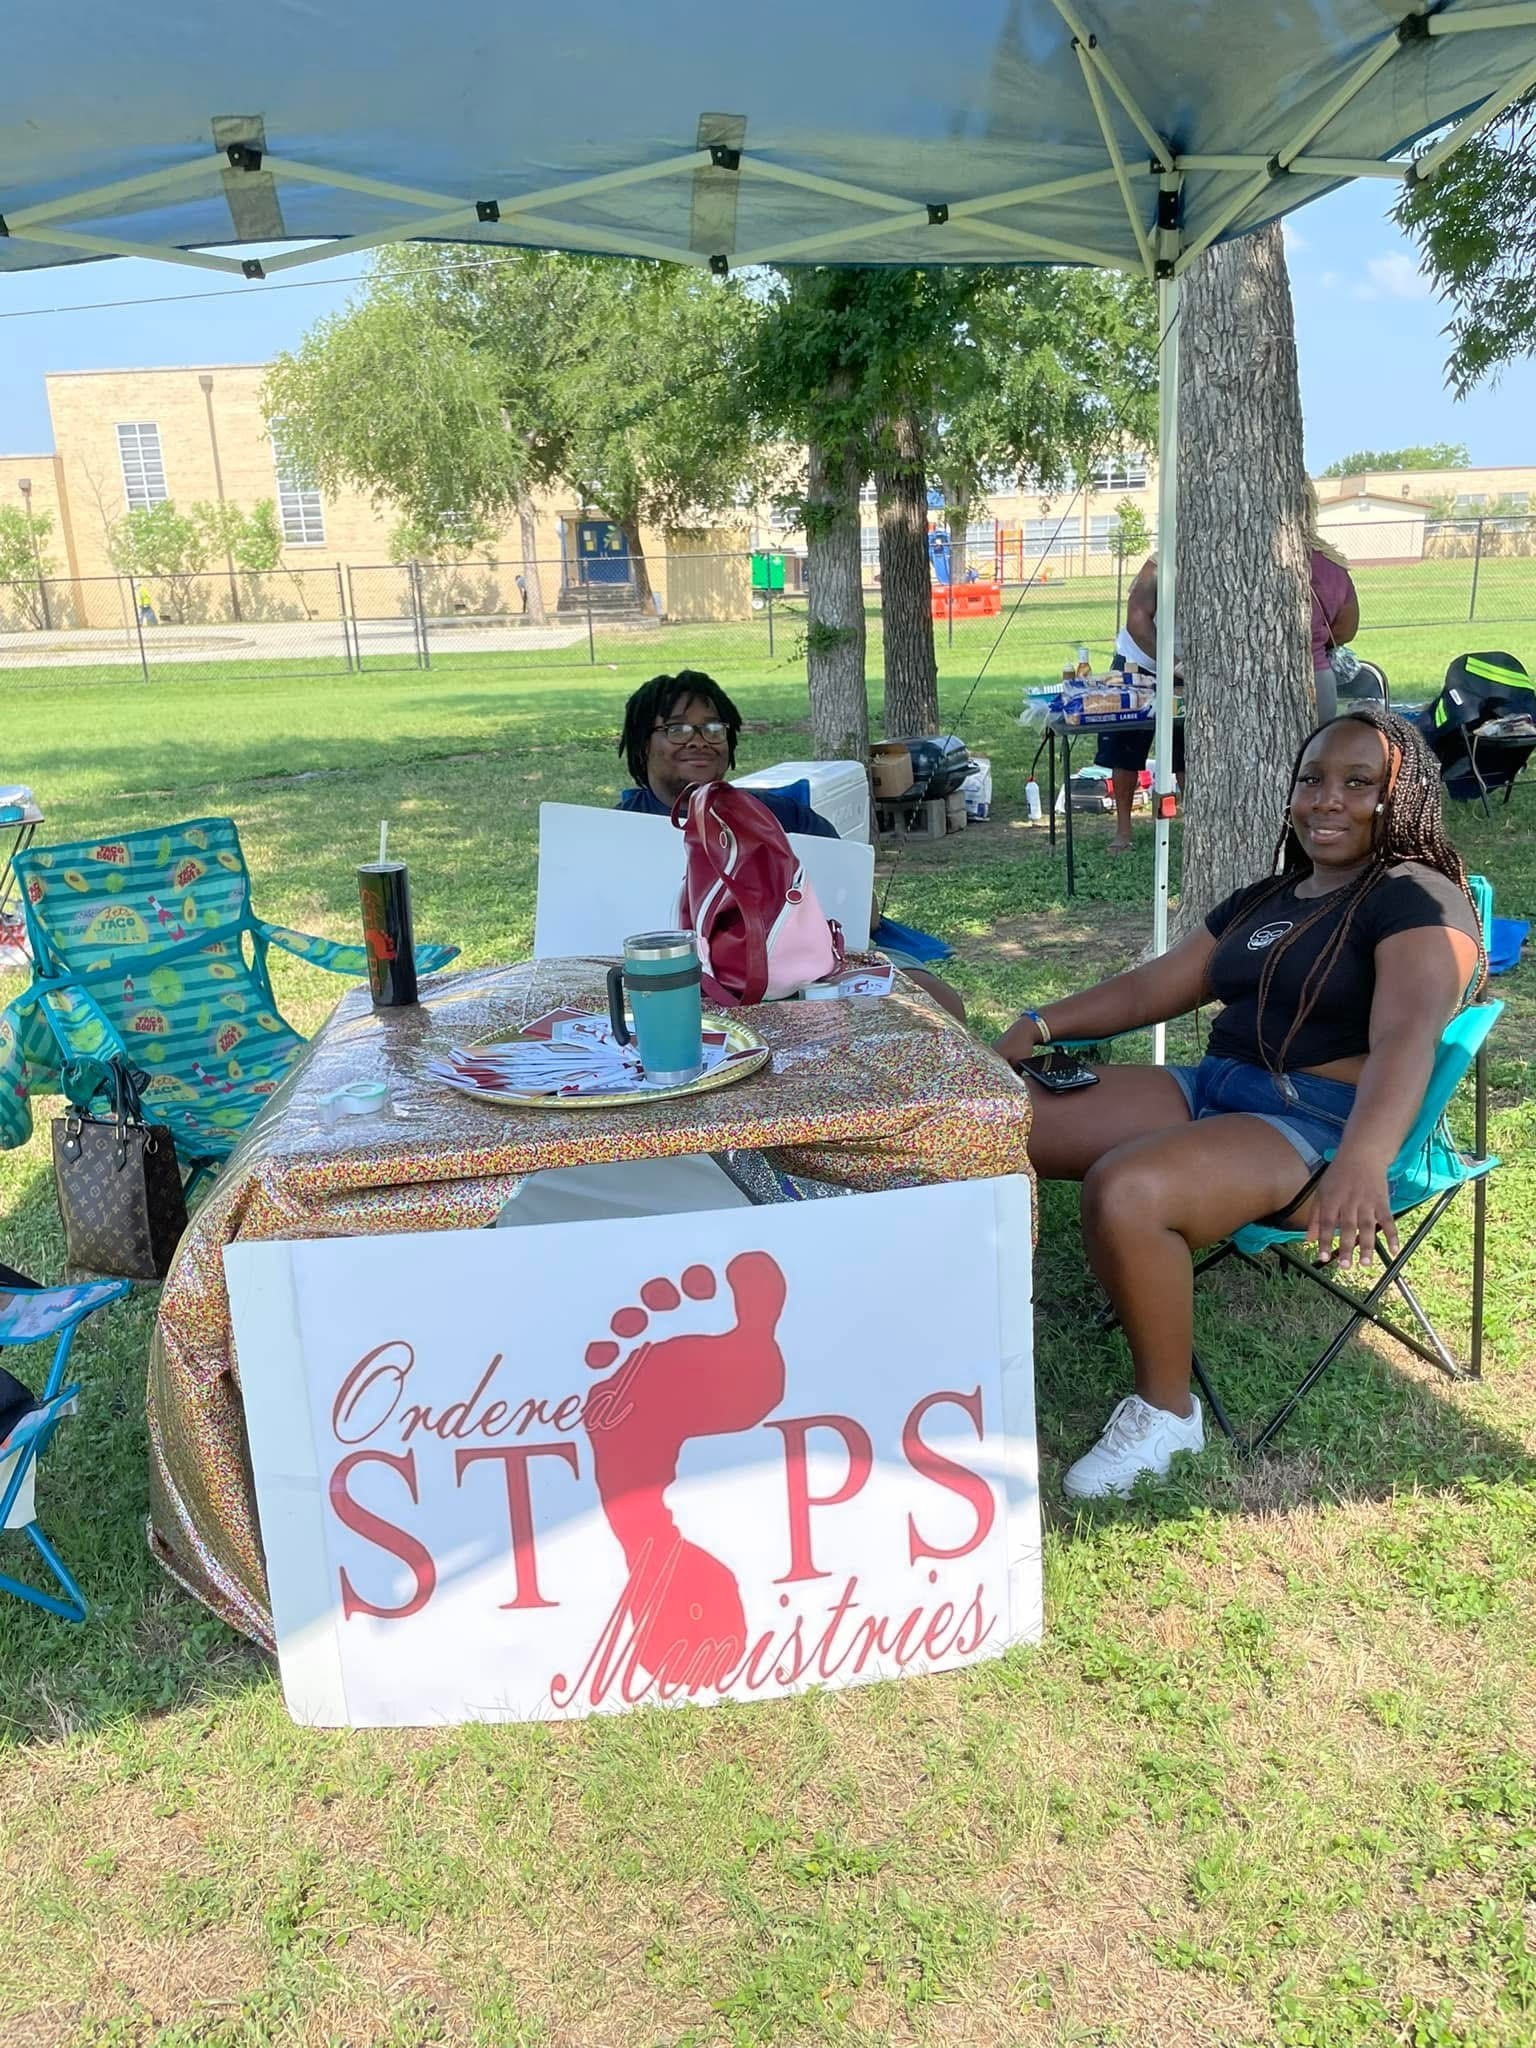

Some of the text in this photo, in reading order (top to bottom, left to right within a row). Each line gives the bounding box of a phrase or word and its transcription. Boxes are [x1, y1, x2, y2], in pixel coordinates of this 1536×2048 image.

[101, 917, 136, 929] TACO
[136, 1016, 163, 1024] TACO
[332, 1340, 653, 1444] Ordered
[550, 1537, 998, 1709] Ministries
